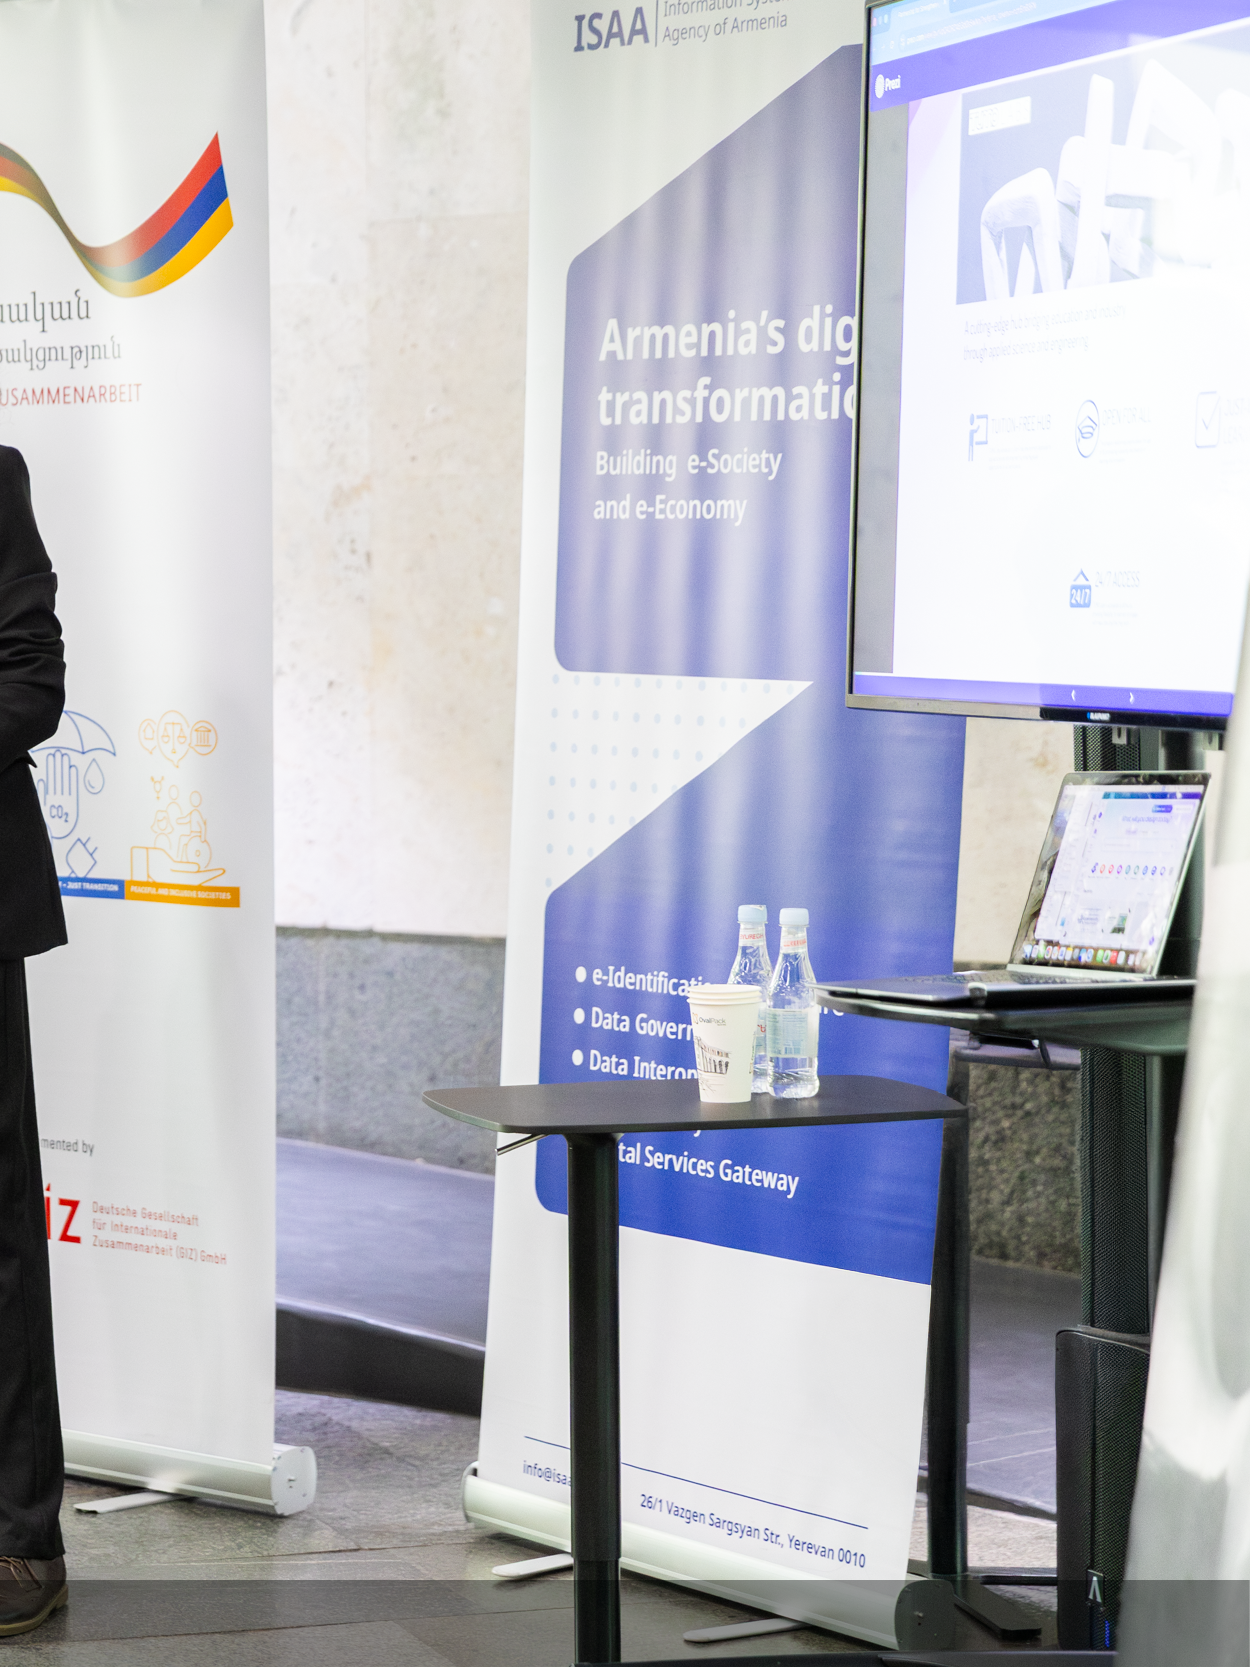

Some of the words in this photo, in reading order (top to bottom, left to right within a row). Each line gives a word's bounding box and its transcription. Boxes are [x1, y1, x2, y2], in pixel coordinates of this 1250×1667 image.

[573, 6, 650, 52] ISAA
[662, 22, 710, 46] Agency
[713, 17, 729, 36] of
[729, 11, 788, 34] Armenia
[598, 309, 786, 362] Armenia’s
[595, 448, 677, 482] Building
[687, 447, 783, 481] e-Society
[593, 493, 631, 519] and
[635, 494, 747, 527] e-Economy
[1070, 588, 1090, 605] 24/7
[591, 1007, 630, 1033] Data
[589, 1049, 629, 1076] Data
[82, 1140, 95, 1157] by
[644, 1145, 715, 1179] Services
[719, 1159, 800, 1199] Gateway
[92, 1201, 137, 1218] Deutsche
[141, 1207, 199, 1227] Gesellschaft
[92, 1218, 107, 1230] für
[110, 1220, 178, 1241] Internationale
[92, 1234, 173, 1257] Zusammenarbeit
[175, 1245, 198, 1263] (GIZ)
[200, 1249, 227, 1265] GmbH
[639, 1493, 664, 1514] 26/1
[666, 1501, 706, 1526] Vazgen
[708, 1512, 760, 1540] Sargsyan
[786, 1533, 835, 1560] Yerevan
[837, 1547, 866, 1569] 0010
